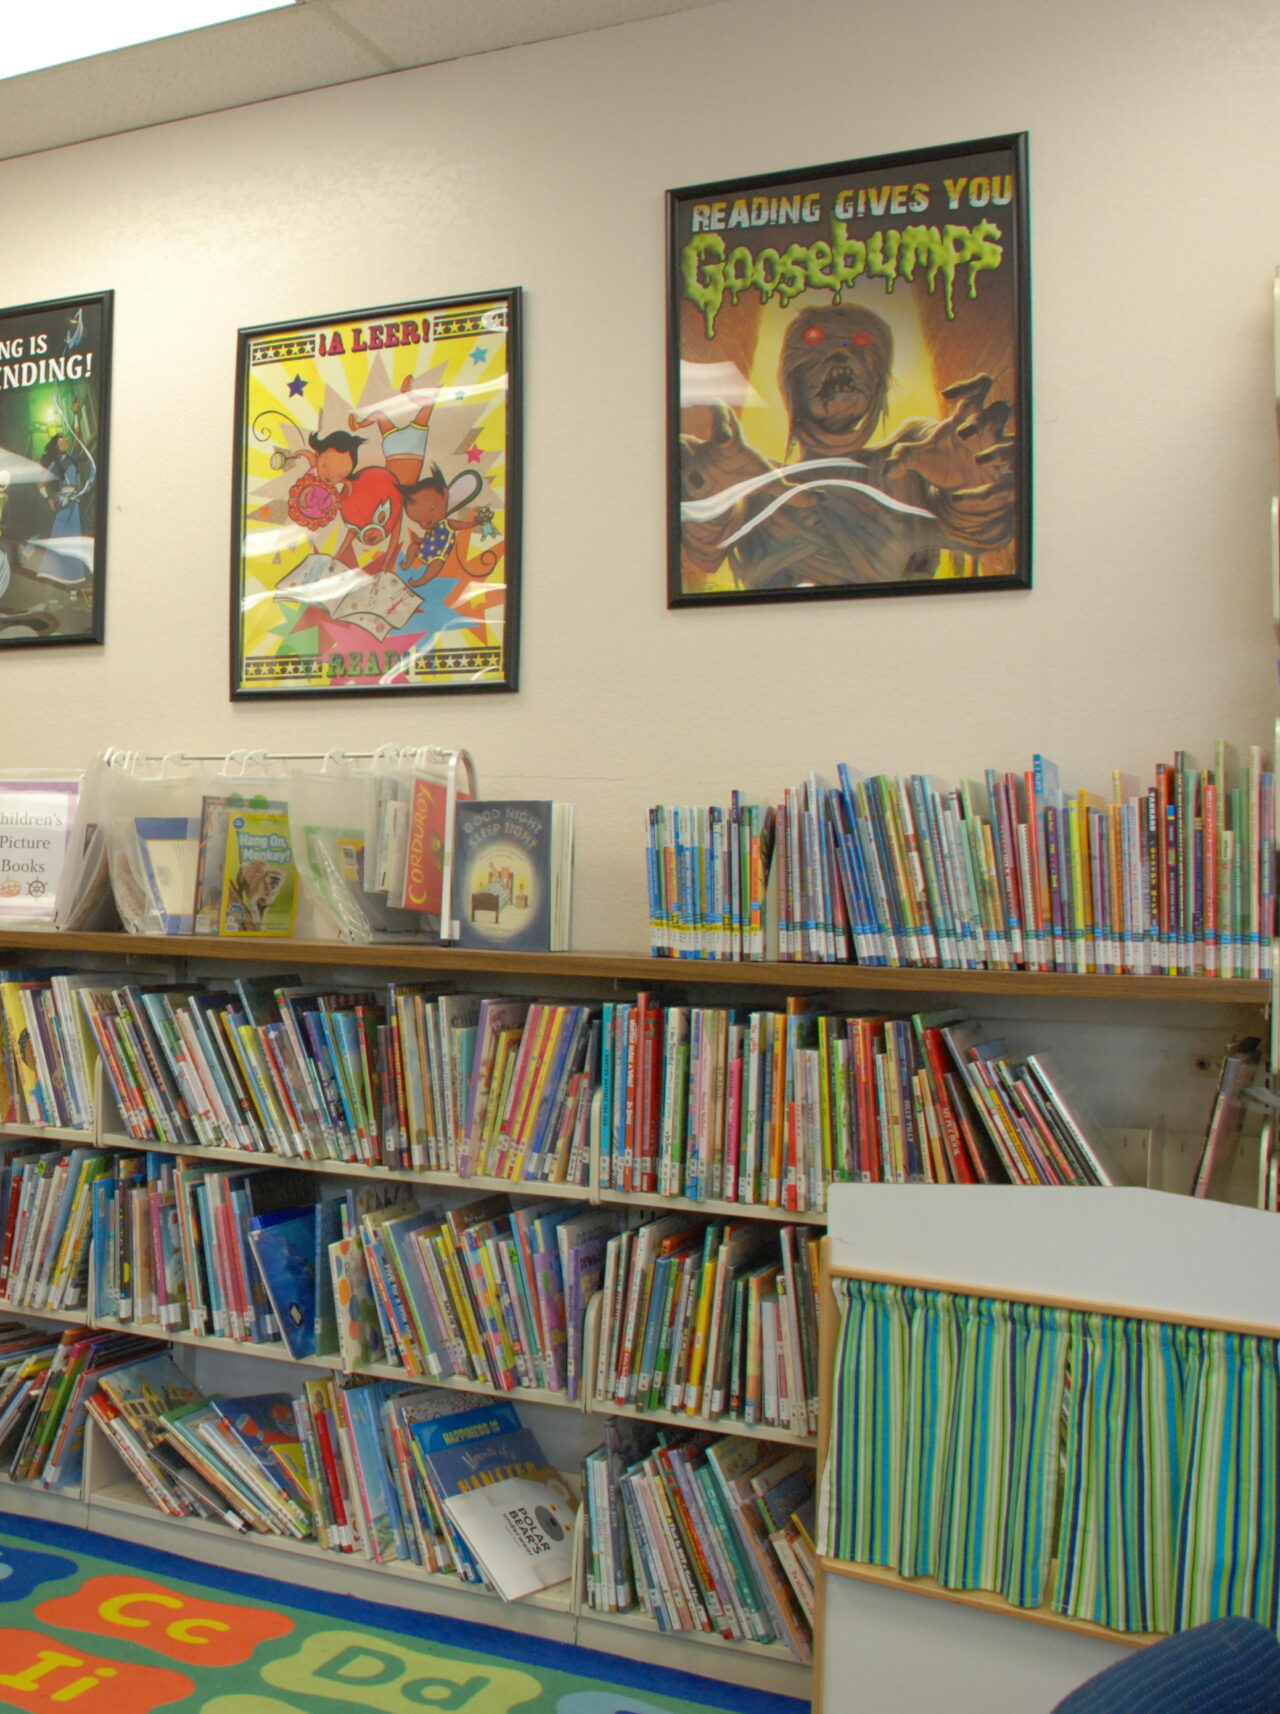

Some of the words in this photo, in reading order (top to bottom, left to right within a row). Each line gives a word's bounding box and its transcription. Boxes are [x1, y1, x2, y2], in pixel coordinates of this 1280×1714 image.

[692, 193, 821, 233] READING
[834, 181, 931, 220] GIVES
[943, 174, 1014, 211] YOU
[29, 334, 48, 355] IS
[350, 318, 431, 355] LEER!
[464, 808, 501, 834] GOOD
[504, 807, 543, 833] NIGHT
[469, 822, 500, 849] SLEEP
[504, 822, 538, 850] TIGHT
[239, 833, 268, 848] Hang
[0, 858, 45, 873] Books
[442, 1422, 490, 1446] HAPPINESS
[509, 1509, 542, 1555] BEAR'S
[516, 1506, 551, 1552] POLAR
[98, 1592, 231, 1645] Cc
[312, 1644, 491, 1712] Dd
